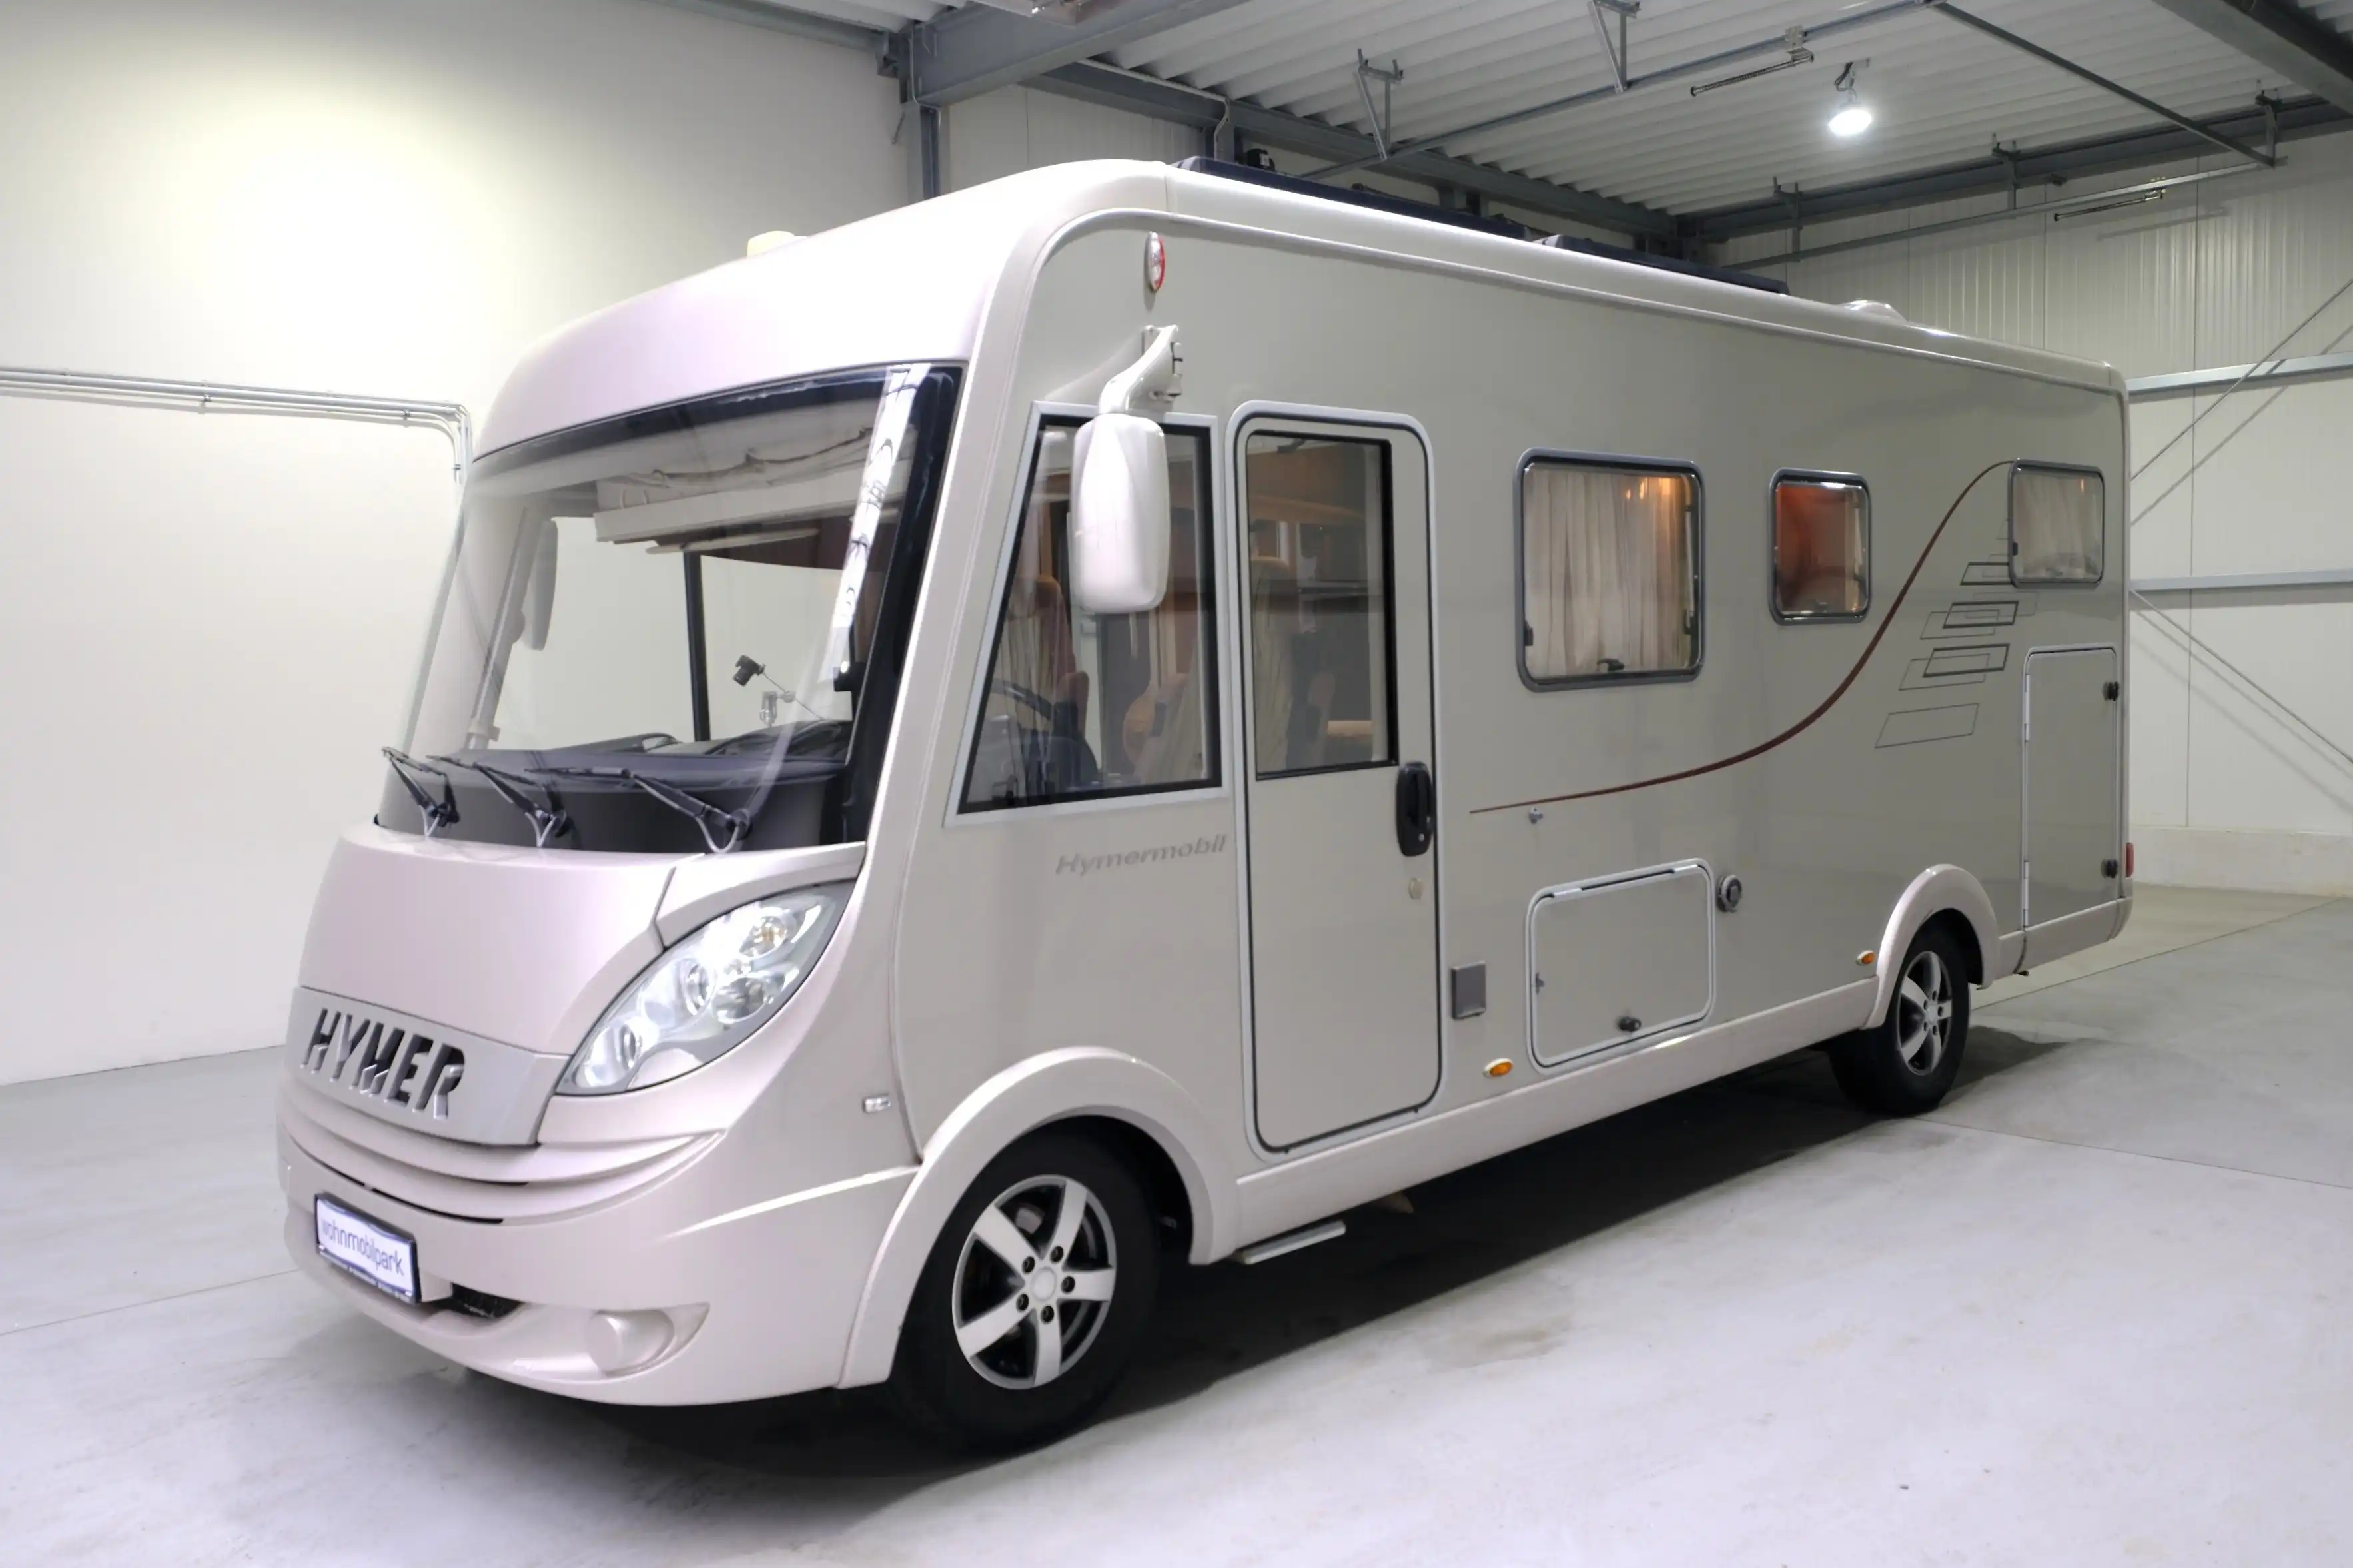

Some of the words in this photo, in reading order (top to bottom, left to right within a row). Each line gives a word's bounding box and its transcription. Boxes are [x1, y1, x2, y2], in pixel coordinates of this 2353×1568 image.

[1055, 834, 1227, 877] Hymermobil
[300, 1007, 466, 1120] HYMER
[321, 1218, 404, 1277] wohnmobilpark
